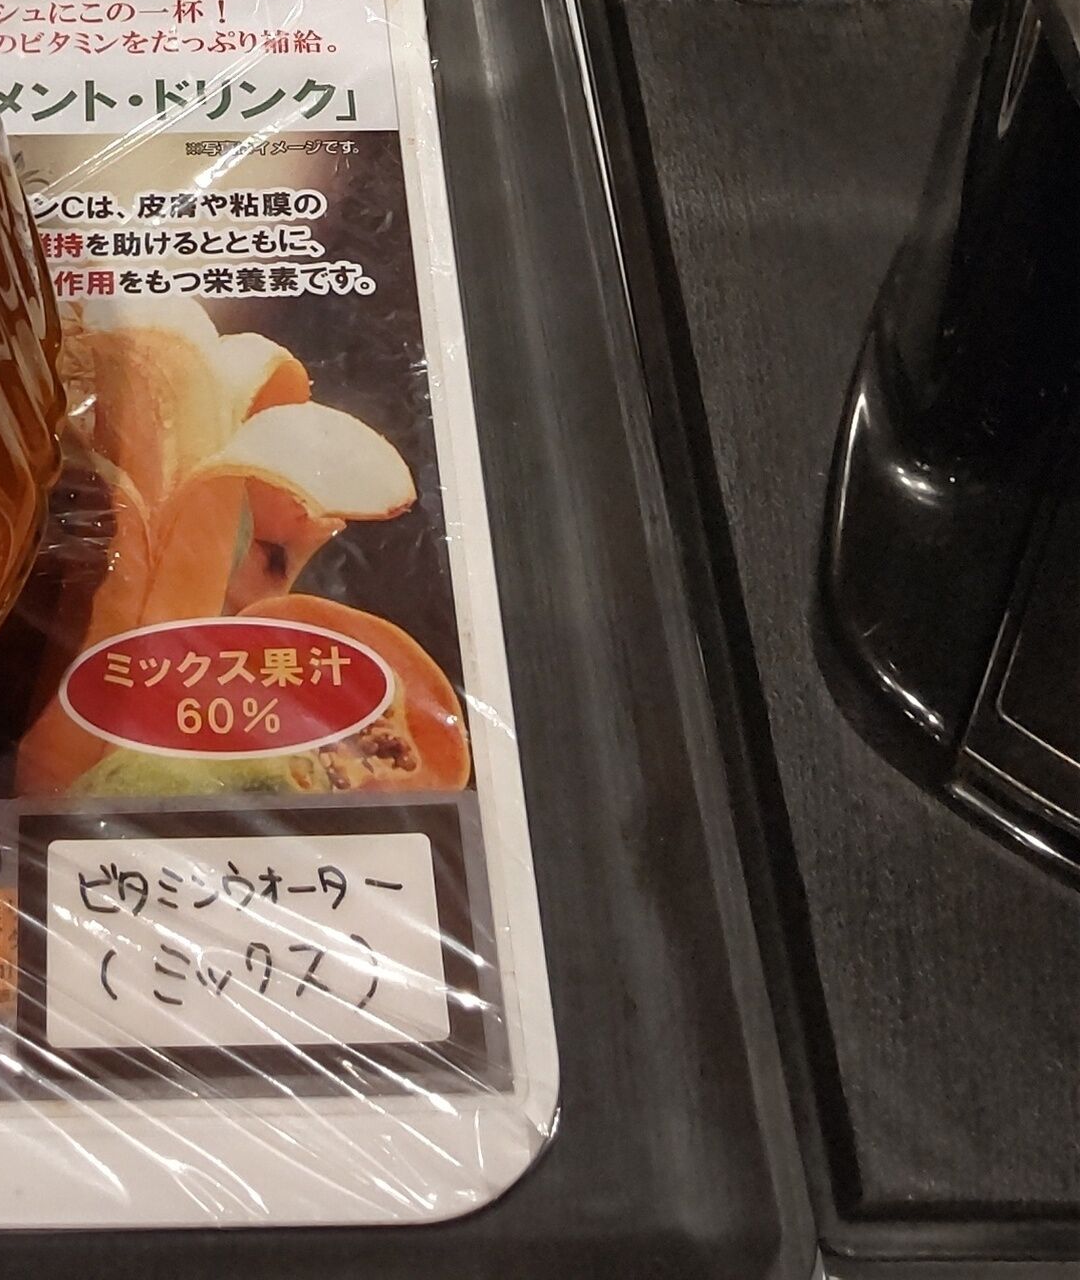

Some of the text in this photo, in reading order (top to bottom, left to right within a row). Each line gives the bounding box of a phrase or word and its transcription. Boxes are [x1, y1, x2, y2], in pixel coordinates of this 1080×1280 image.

[103, 645, 352, 688] ミックス果汁
[176, 696, 281, 735] 60%
